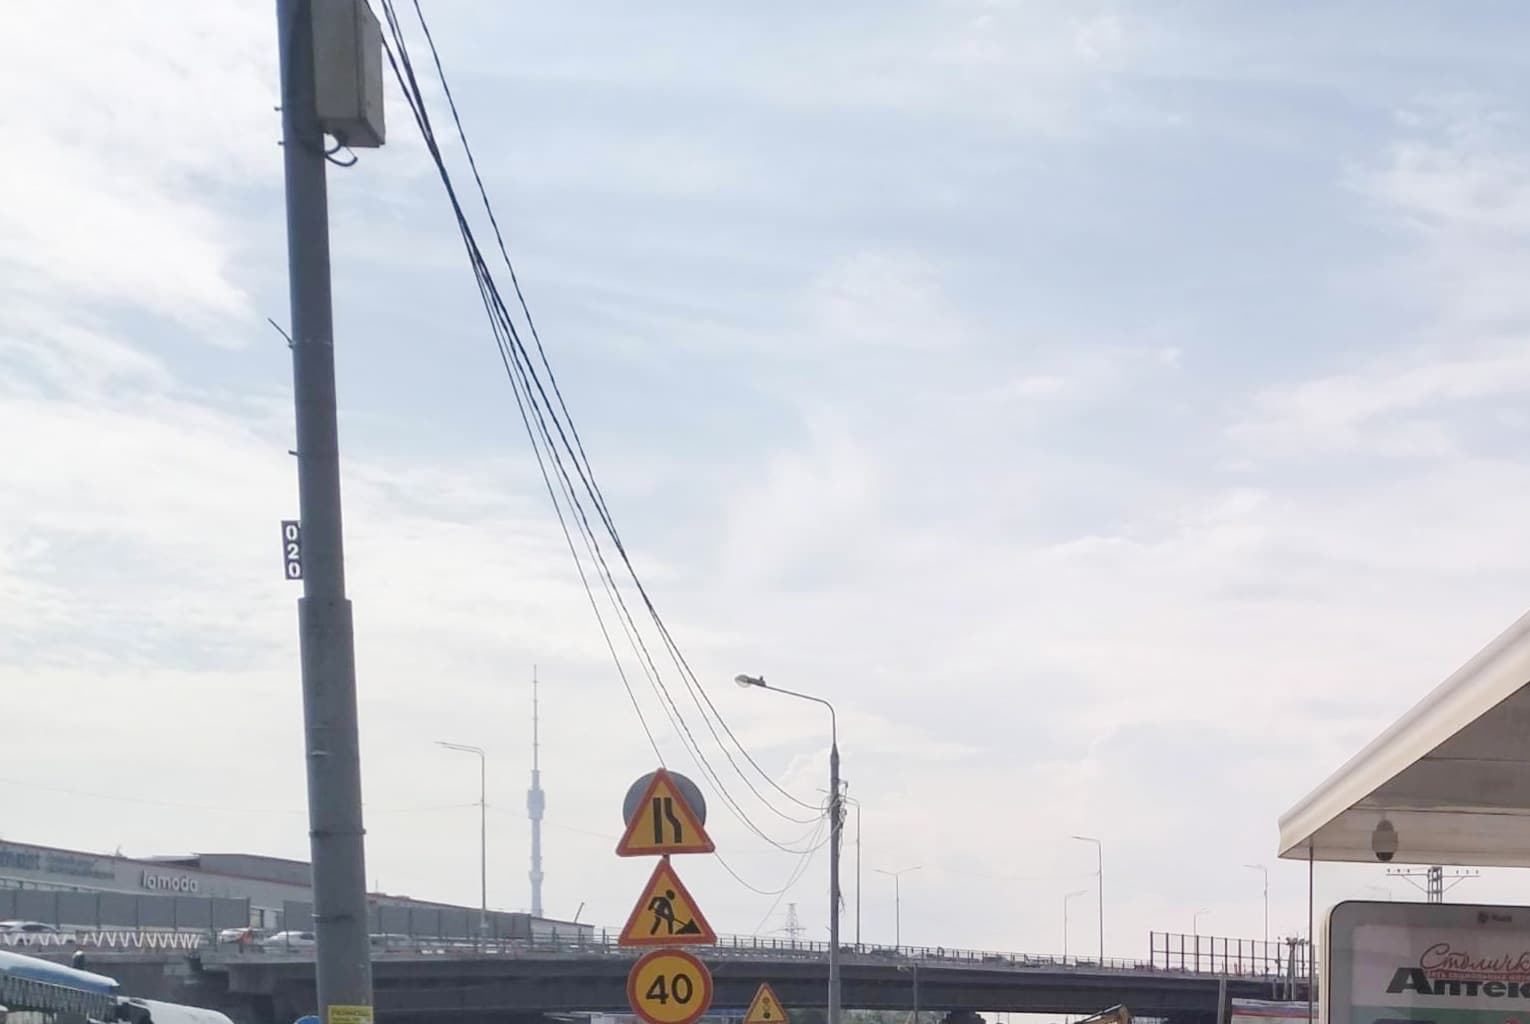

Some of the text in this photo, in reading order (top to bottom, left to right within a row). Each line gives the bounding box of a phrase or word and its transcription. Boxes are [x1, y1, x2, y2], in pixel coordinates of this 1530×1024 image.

[286, 524, 301, 578] 020
[141, 869, 199, 893] lamoda
[646, 973, 693, 1005] 40
